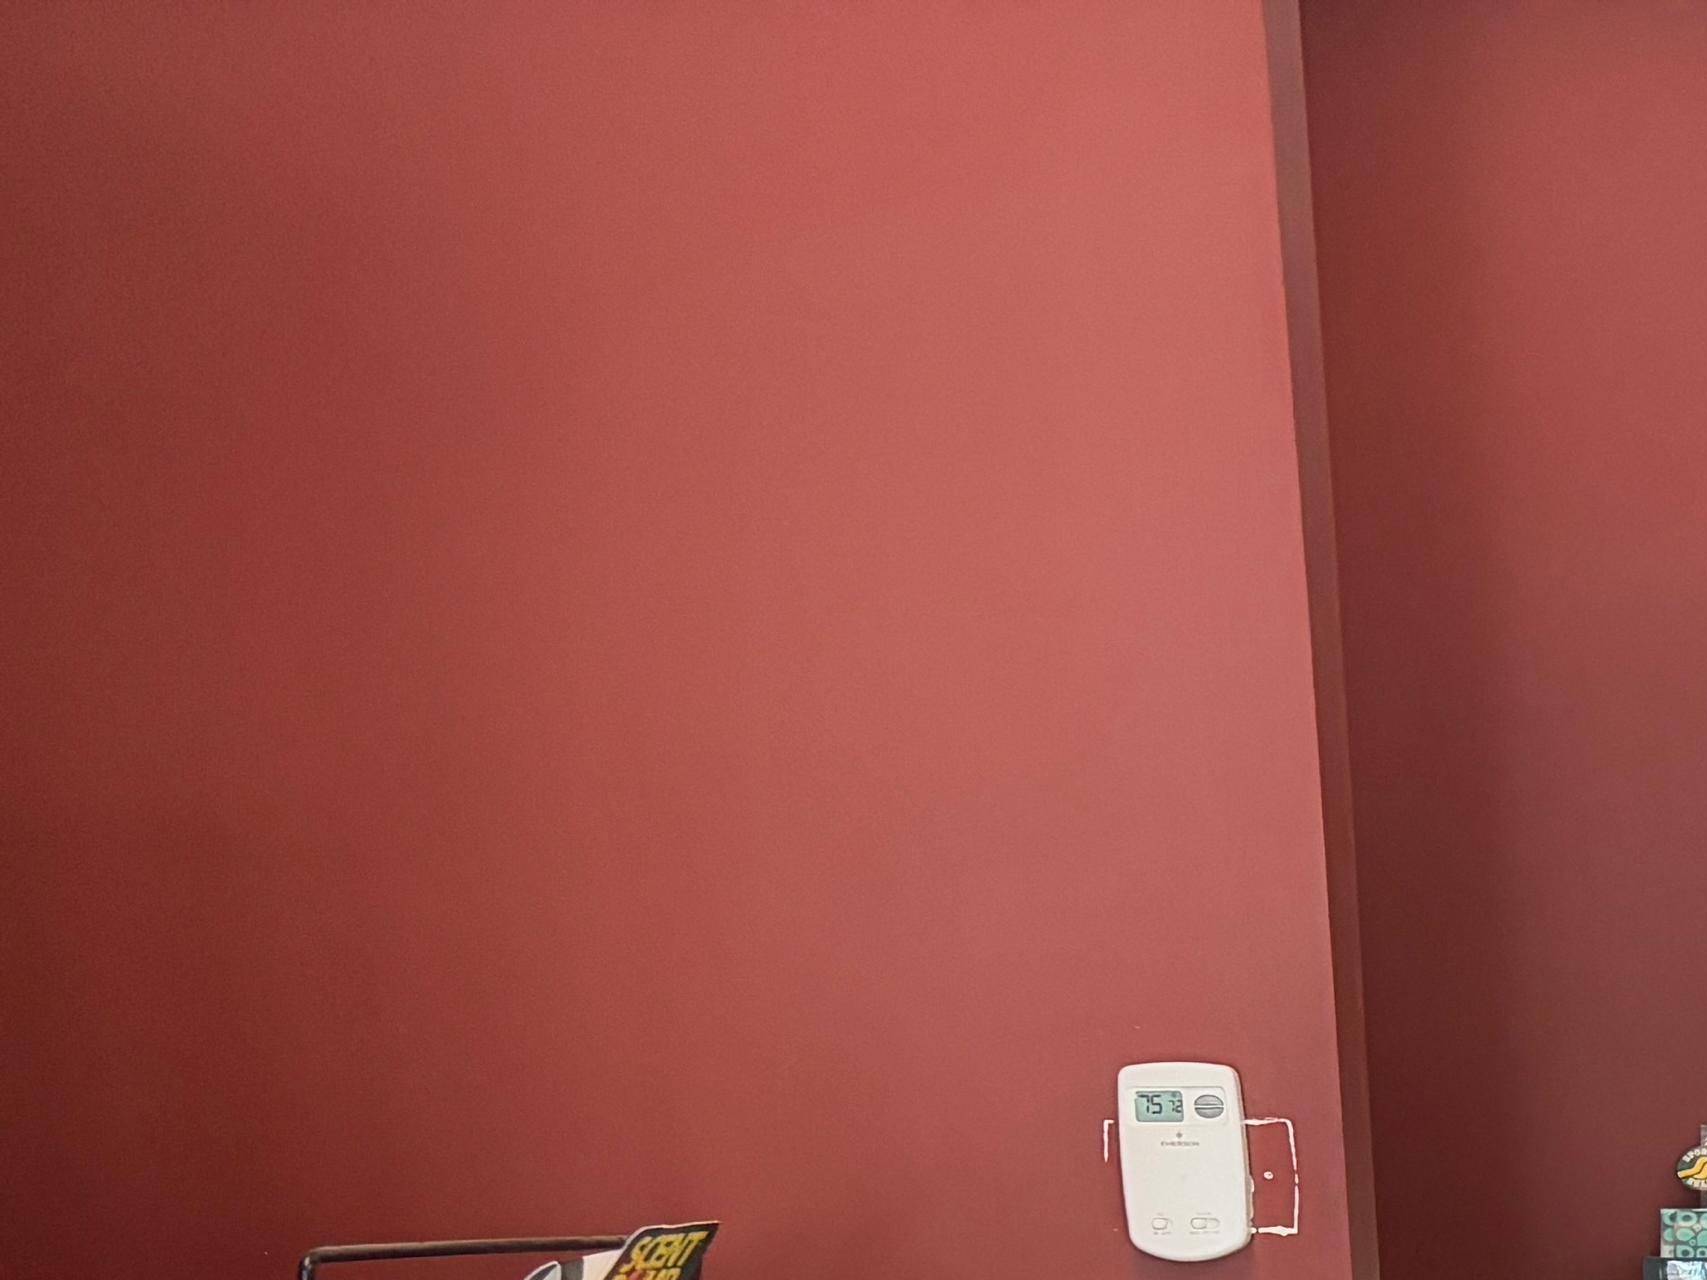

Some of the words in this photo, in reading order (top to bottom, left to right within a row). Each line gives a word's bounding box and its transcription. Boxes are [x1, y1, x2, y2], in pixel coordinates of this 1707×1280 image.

[1137, 1094, 1163, 1114] 75
[1169, 1099, 1182, 1113] 72
[632, 1231, 709, 1270] SCENT
